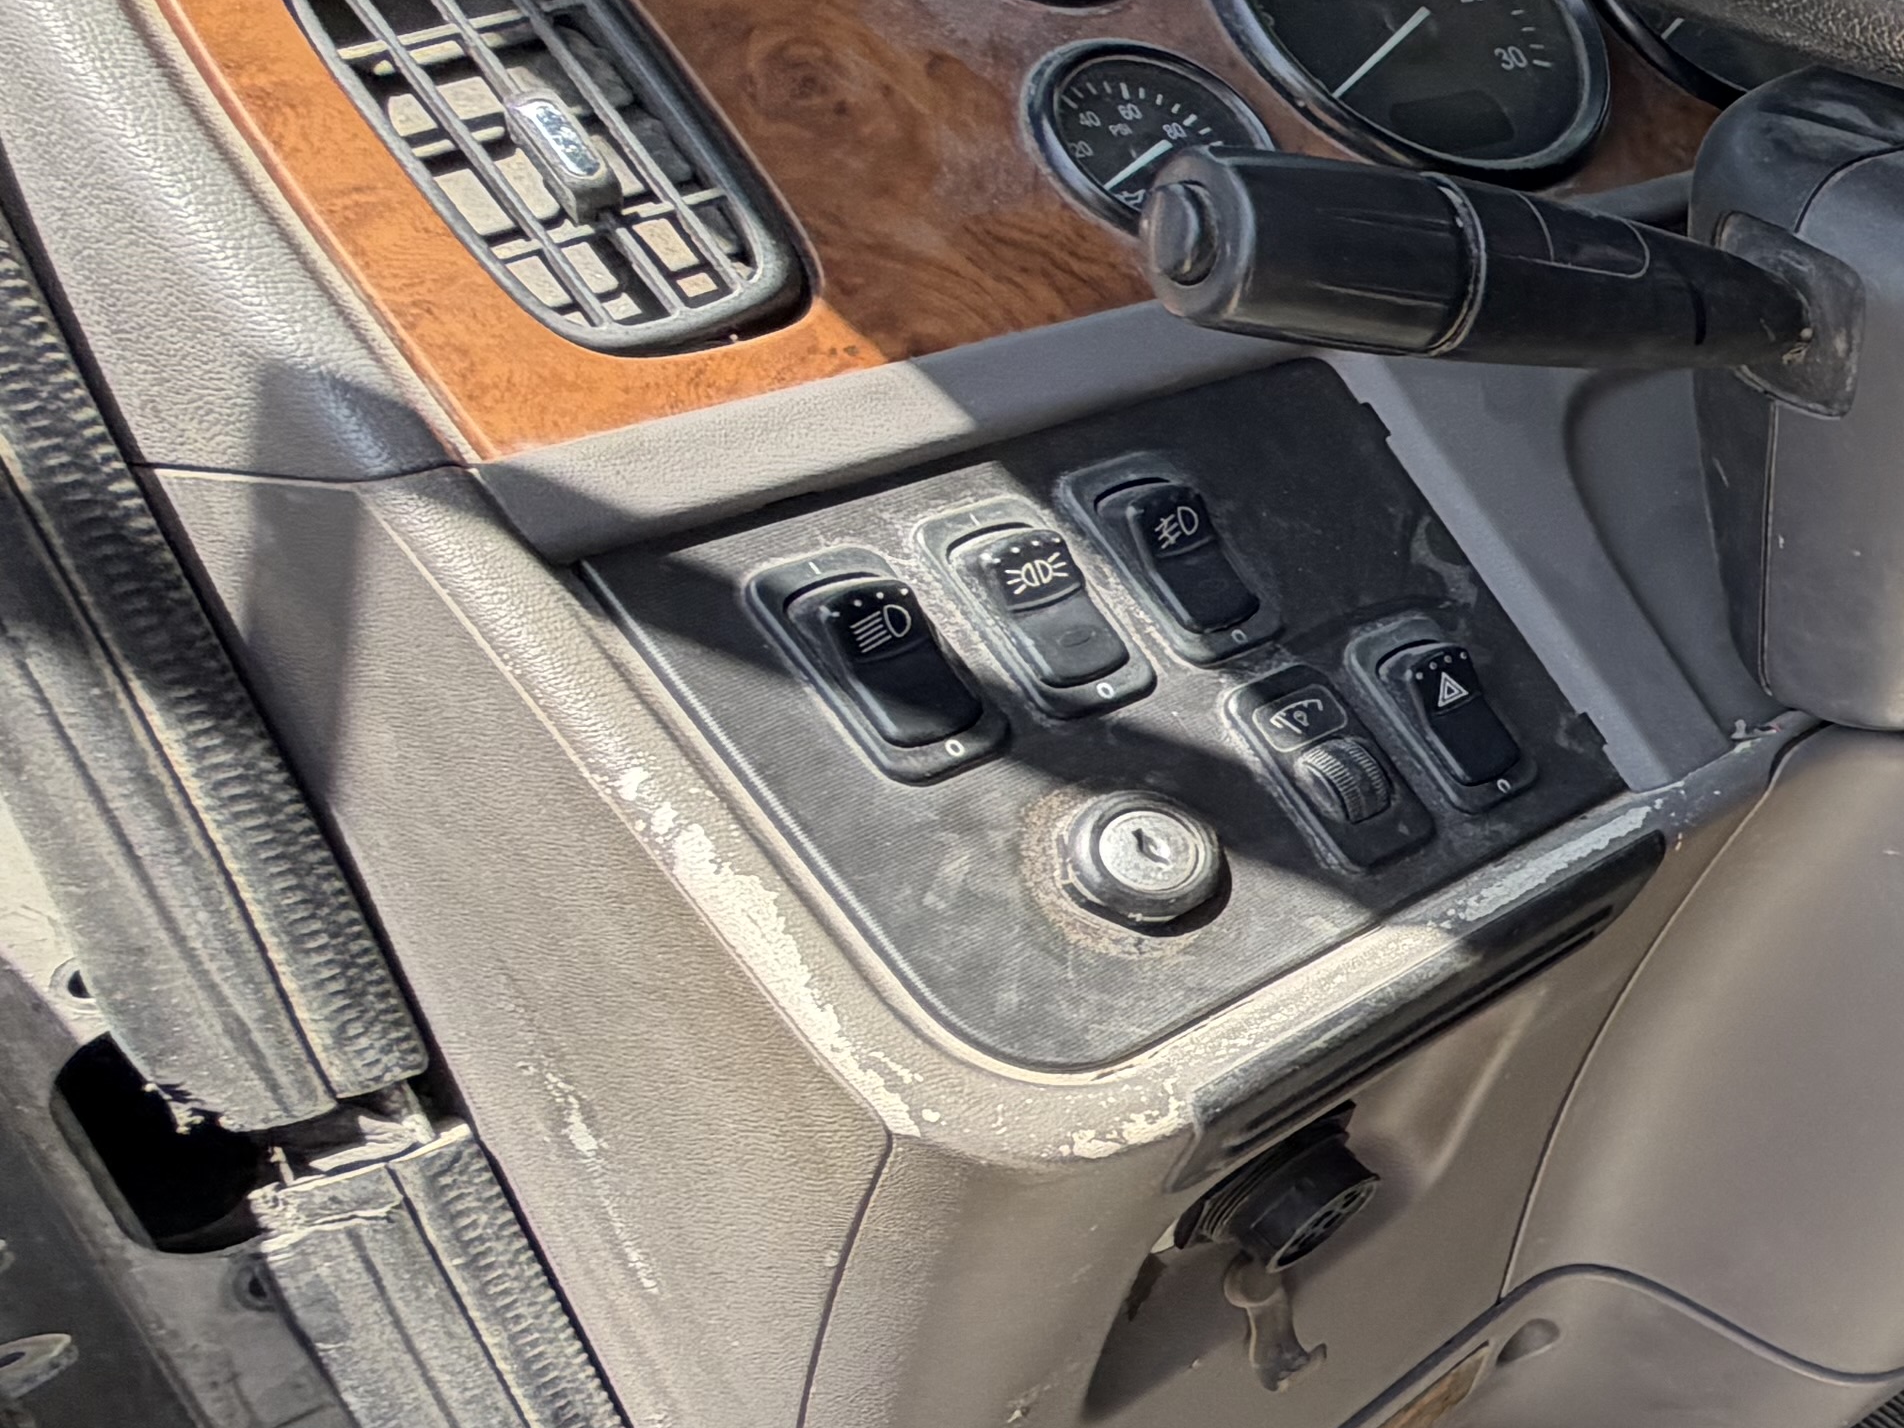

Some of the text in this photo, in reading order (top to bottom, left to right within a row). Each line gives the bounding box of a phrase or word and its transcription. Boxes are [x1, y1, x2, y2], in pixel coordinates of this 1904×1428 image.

[1494, 45, 1529, 71] 30
[1079, 110, 1101, 127] 40
[1117, 103, 1143, 120] 60
[1108, 123, 1133, 137] PSI
[1162, 122, 1187, 140] 80
